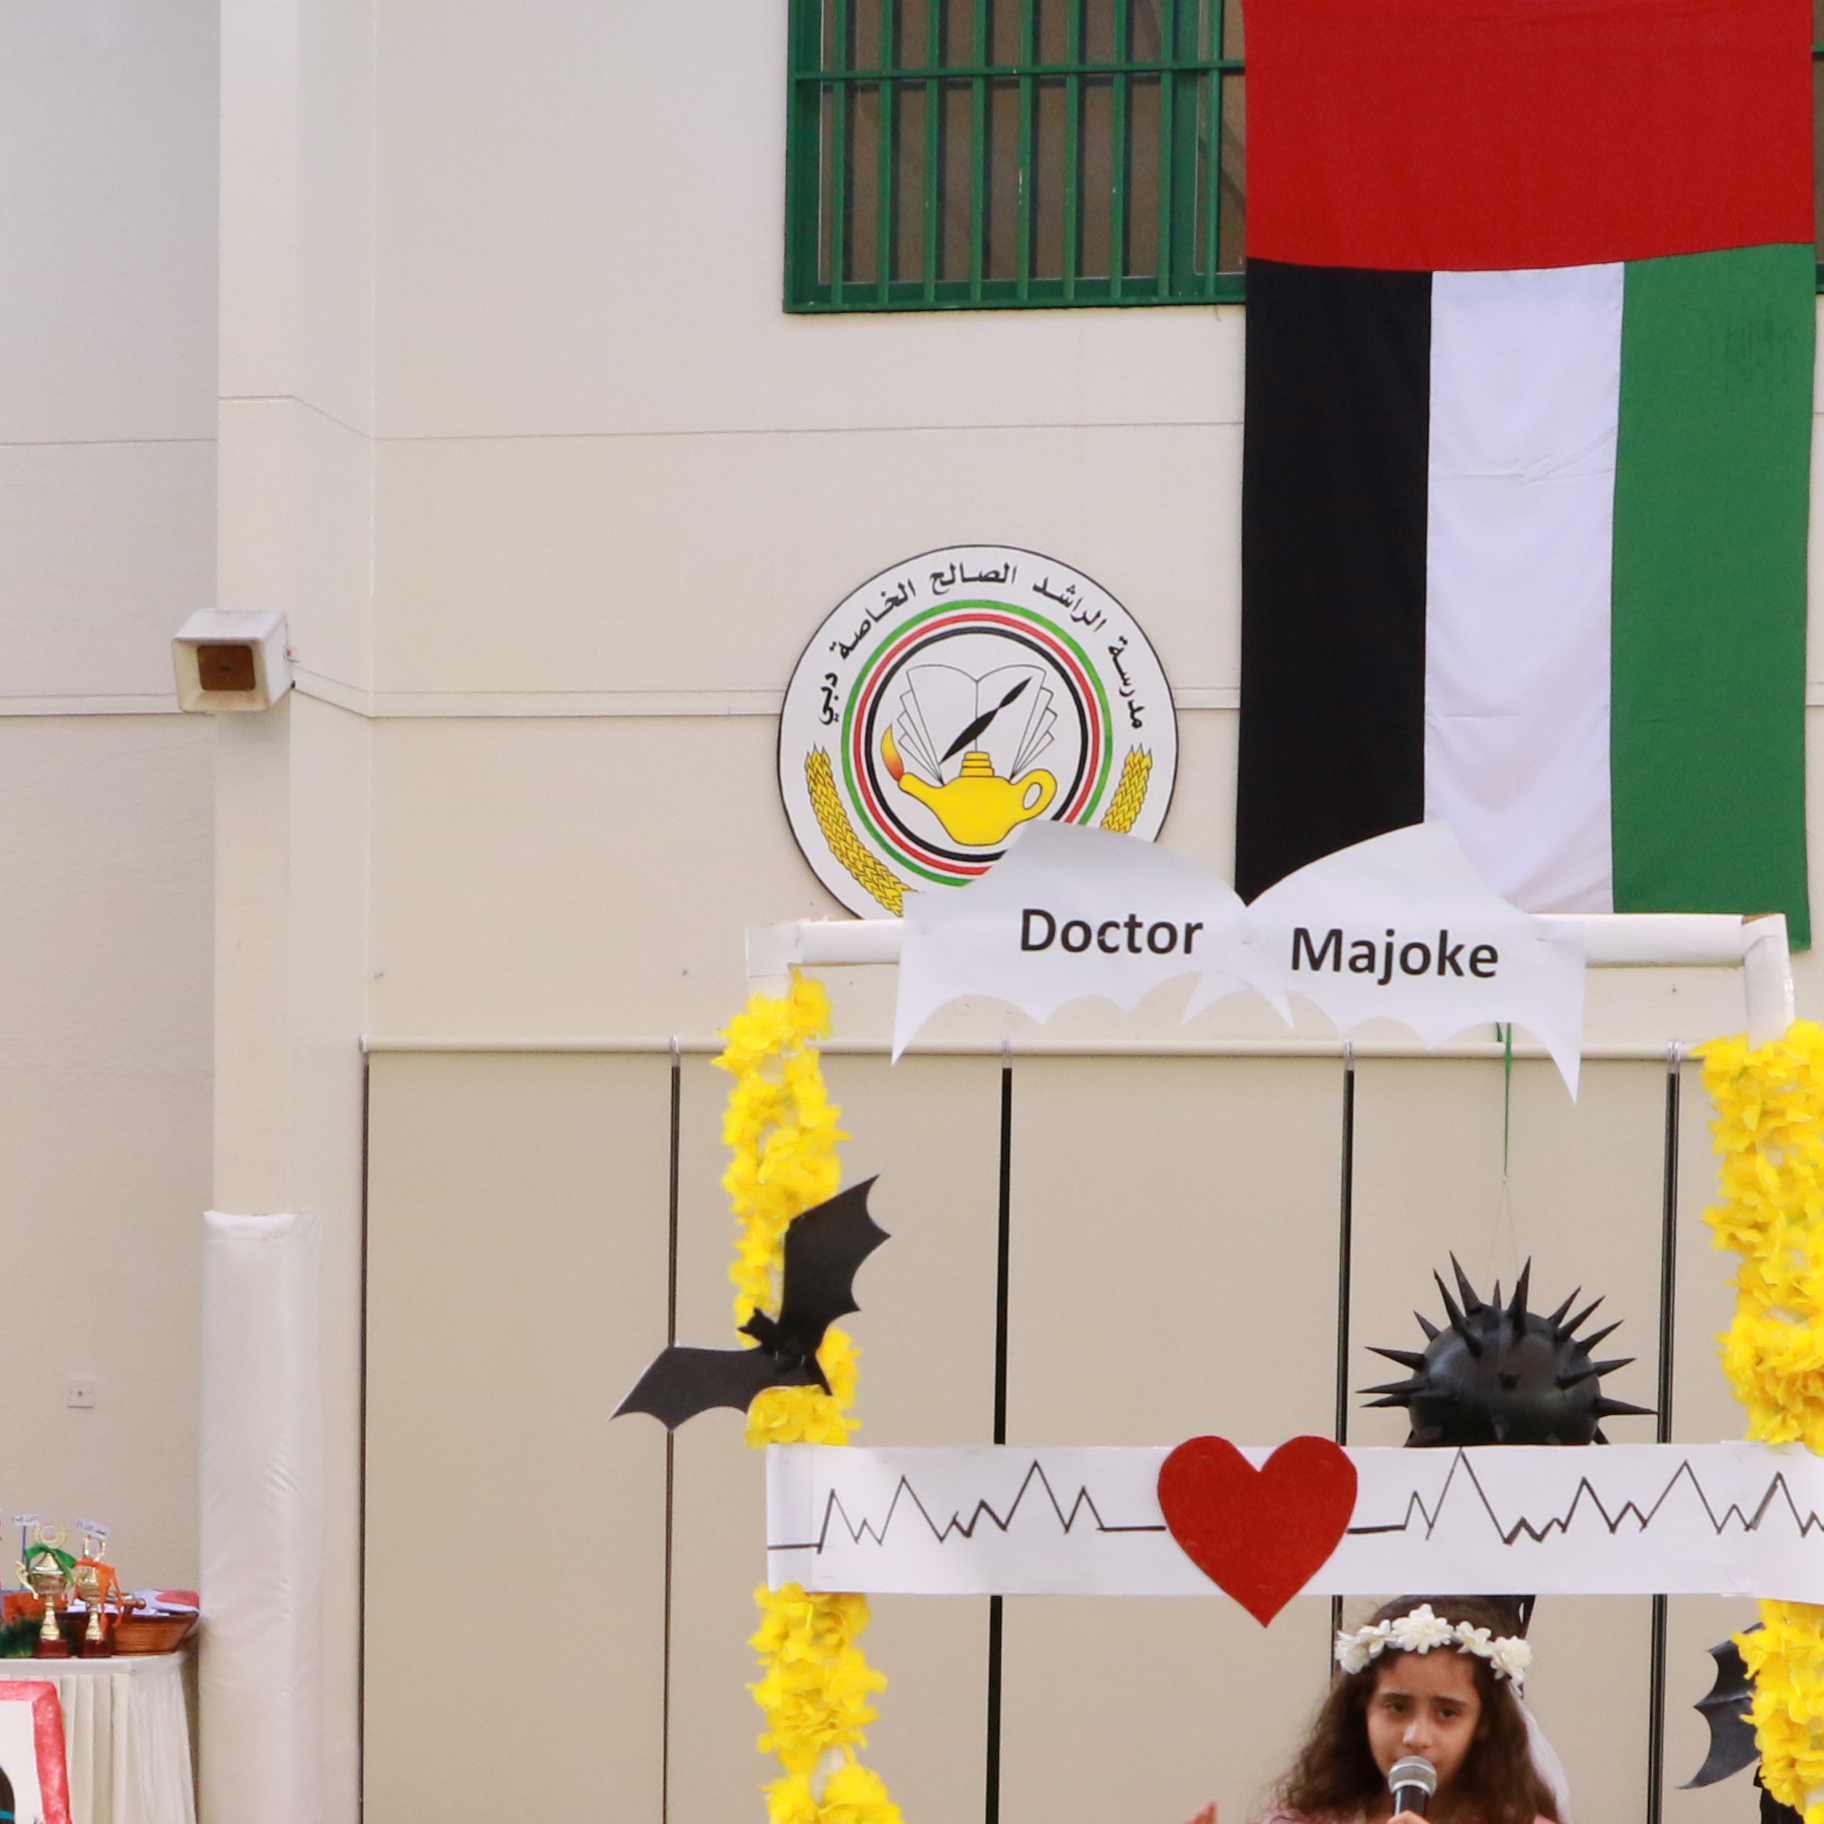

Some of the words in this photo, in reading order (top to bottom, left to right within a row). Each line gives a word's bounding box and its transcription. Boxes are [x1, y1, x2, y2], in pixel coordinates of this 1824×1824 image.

[929, 561, 1018, 596] الصالح
[1031, 576, 1107, 634] الراشد
[828, 578, 917, 661] الخاصة
[816, 672, 839, 726] دبي
[1107, 635, 1147, 729] مدرسة
[1019, 907, 1204, 955] Doctor
[1290, 926, 1500, 986] Majoke
